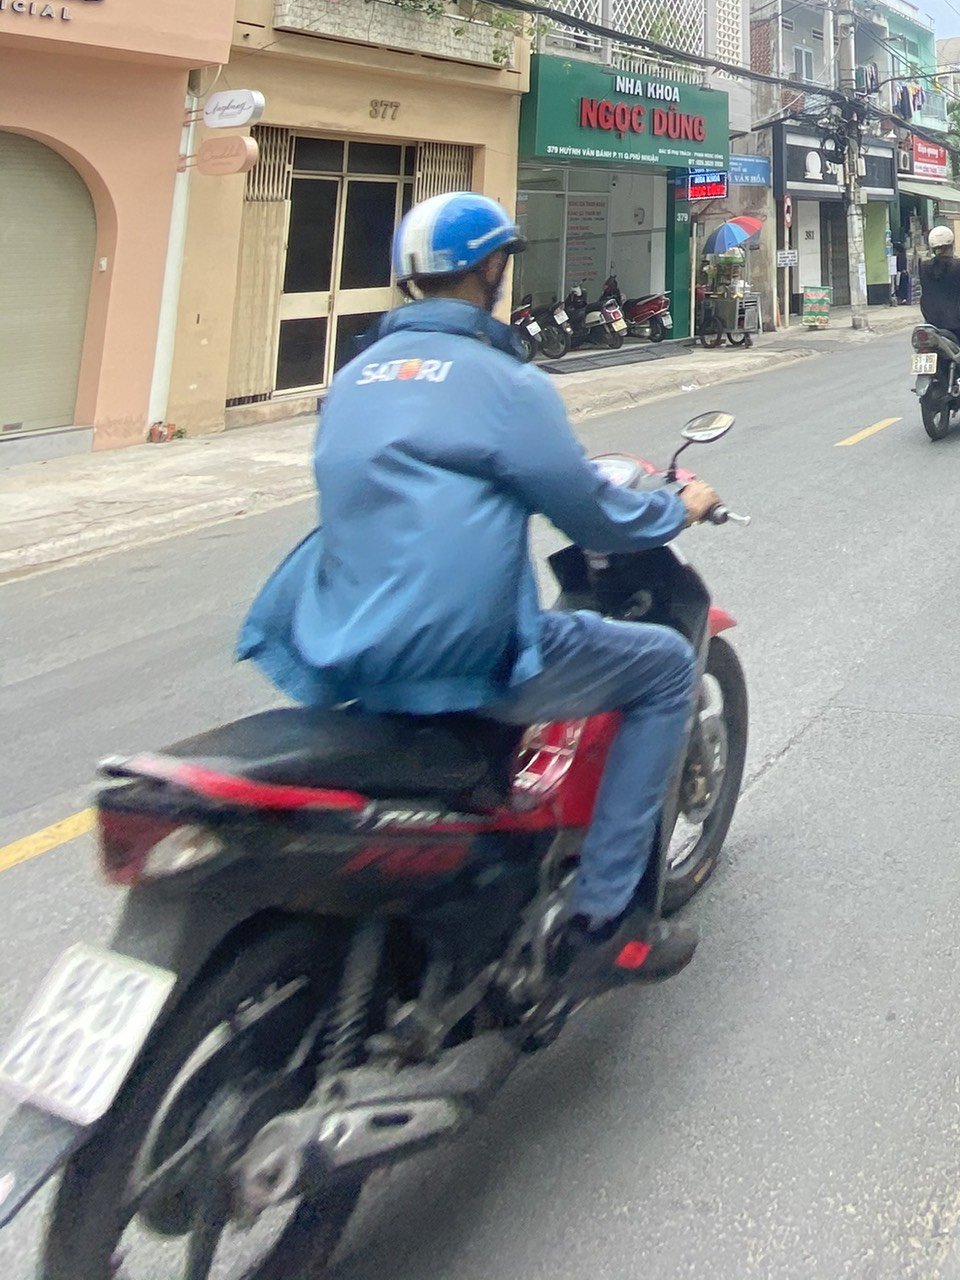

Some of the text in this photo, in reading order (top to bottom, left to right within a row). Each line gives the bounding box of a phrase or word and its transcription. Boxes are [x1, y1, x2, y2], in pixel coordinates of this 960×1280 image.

[615, 75, 680, 103] NHA KHOA
[369, 98, 400, 121] 377
[580, 97, 647, 140] NGỌC
[546, 145, 559, 154] 379
[676, 212, 688, 222] 379
